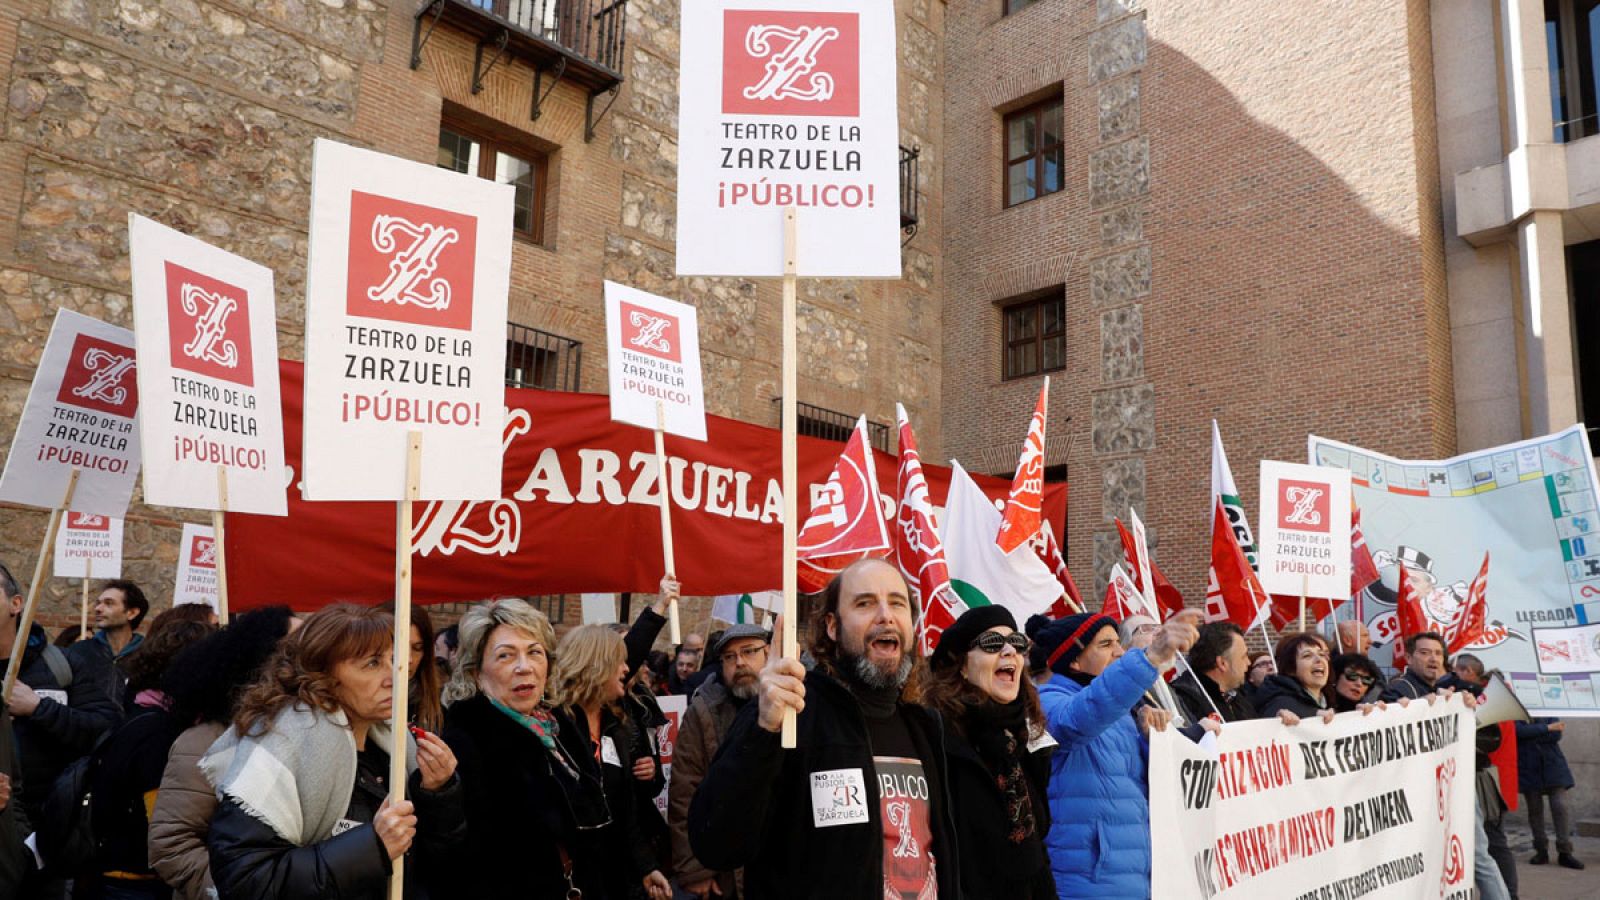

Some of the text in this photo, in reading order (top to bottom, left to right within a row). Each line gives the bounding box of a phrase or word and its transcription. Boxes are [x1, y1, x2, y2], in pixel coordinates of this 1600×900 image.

[722, 123, 861, 141] TEATRO DE LA
[721, 147, 861, 171] ZARZUELA
[718, 176, 874, 208] ¡PÚBLICO!
[345, 326, 472, 357] TEATRO DE LA
[345, 354, 471, 388] ZARZUELA
[622, 351, 684, 375] TEATRO DE LA
[622, 362, 685, 388] ZARZUELA
[172, 376, 256, 410] TEATRO DE LA
[623, 379, 691, 406] ¡PÚBLICO!
[53, 407, 133, 434] TEATRO DE LA
[172, 401, 257, 437] ZARZUELA
[342, 390, 480, 427] ¡PÚBLICO!
[46, 422, 128, 451] ZARZUELA
[37, 444, 129, 474] ¡PÚBLICO!
[174, 434, 266, 470] ¡PÚBLICO!
[1277, 544, 1331, 558] ZARZUELA
[1278, 532, 1331, 545] TEATRO DE LA
[1275, 559, 1336, 576] ¡PÚBLICO!
[1515, 607, 1575, 622] LLEGADA
[1298, 740, 1336, 780] DEL
[1334, 729, 1383, 773] TEATRO
[1385, 726, 1402, 762] DE
[1399, 723, 1417, 757] LA
[338, 821, 350, 829] NO
[818, 809, 865, 821] ZARZUELA
[1343, 801, 1370, 843] DEL
[1368, 788, 1414, 835] INAEM
[1332, 867, 1378, 900] INTERESES
[1376, 852, 1424, 887] PRIVADOS
